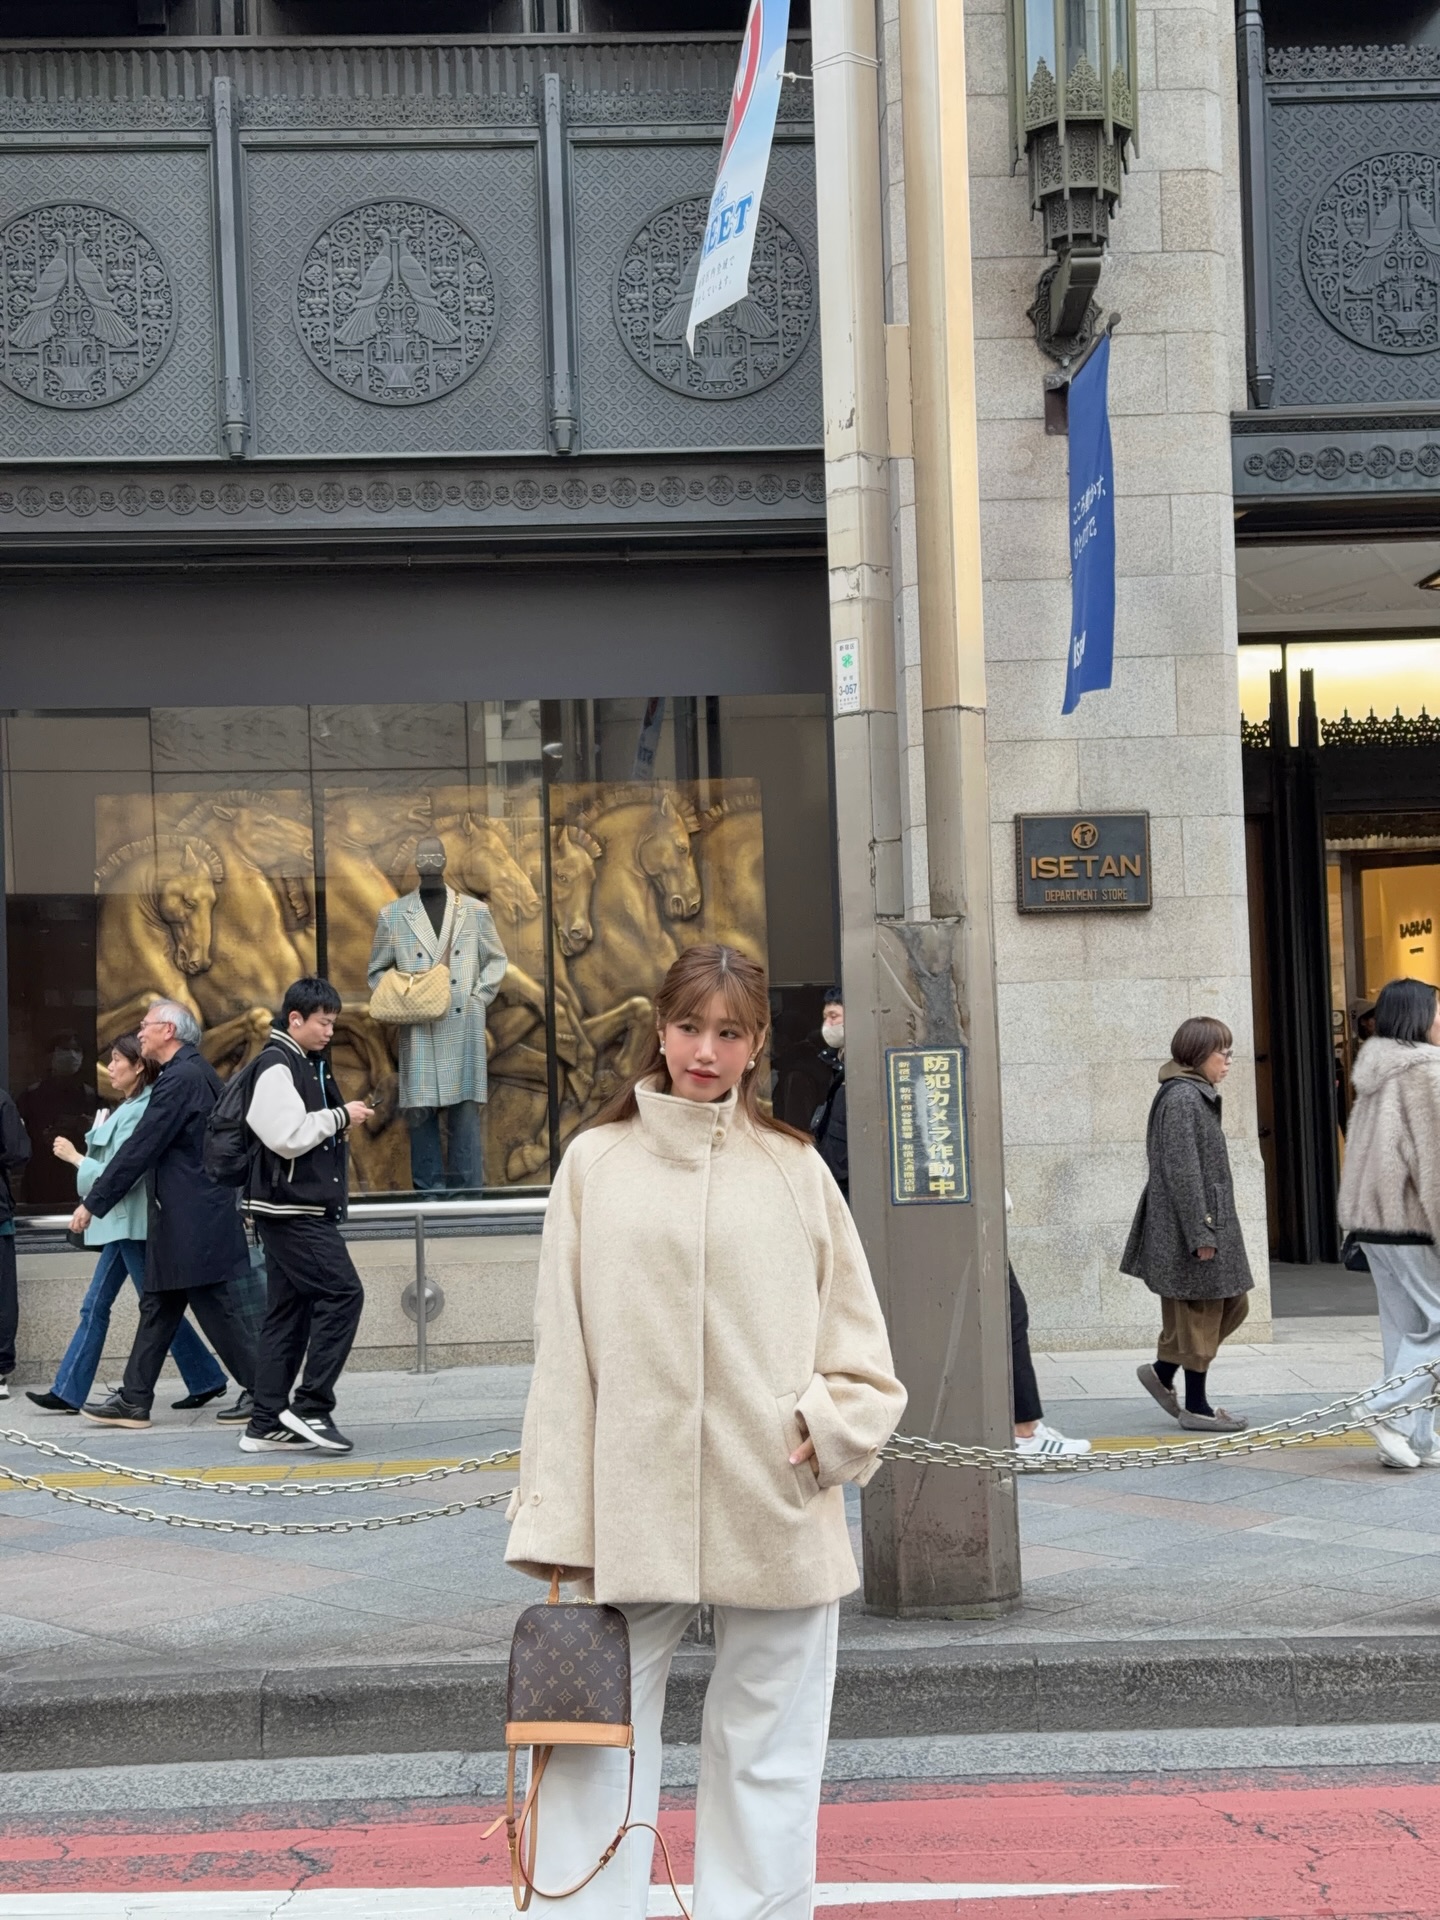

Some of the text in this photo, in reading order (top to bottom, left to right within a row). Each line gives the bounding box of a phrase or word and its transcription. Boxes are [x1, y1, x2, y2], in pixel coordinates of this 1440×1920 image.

[839, 683, 858, 696] 3-057
[1030, 854, 1141, 879] ISETAN
[1045, 888, 1128, 902] DEPARTMENT STORE
[923, 1056, 956, 1195] 防犯カメラ作動中
